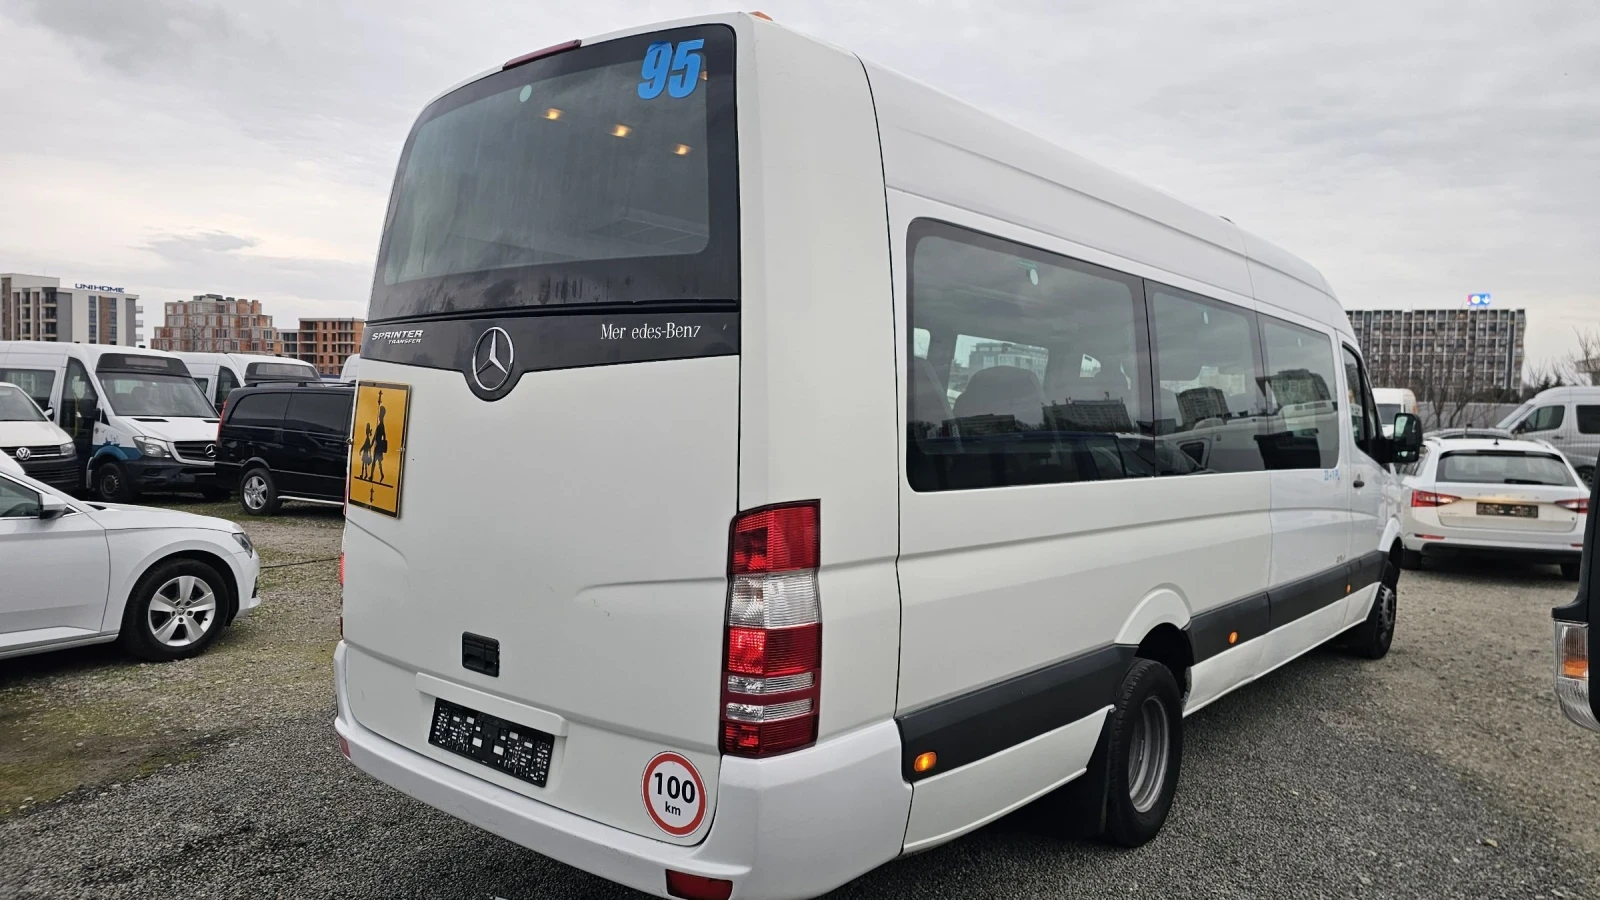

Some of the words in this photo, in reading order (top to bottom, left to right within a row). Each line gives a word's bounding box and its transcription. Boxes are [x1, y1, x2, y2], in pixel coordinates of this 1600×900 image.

[637, 38, 705, 100] 95
[75, 283, 125, 293] UNIHOME
[371, 329, 424, 340] SPRINTER
[654, 772, 696, 804] 100
[664, 800, 682, 817] km
